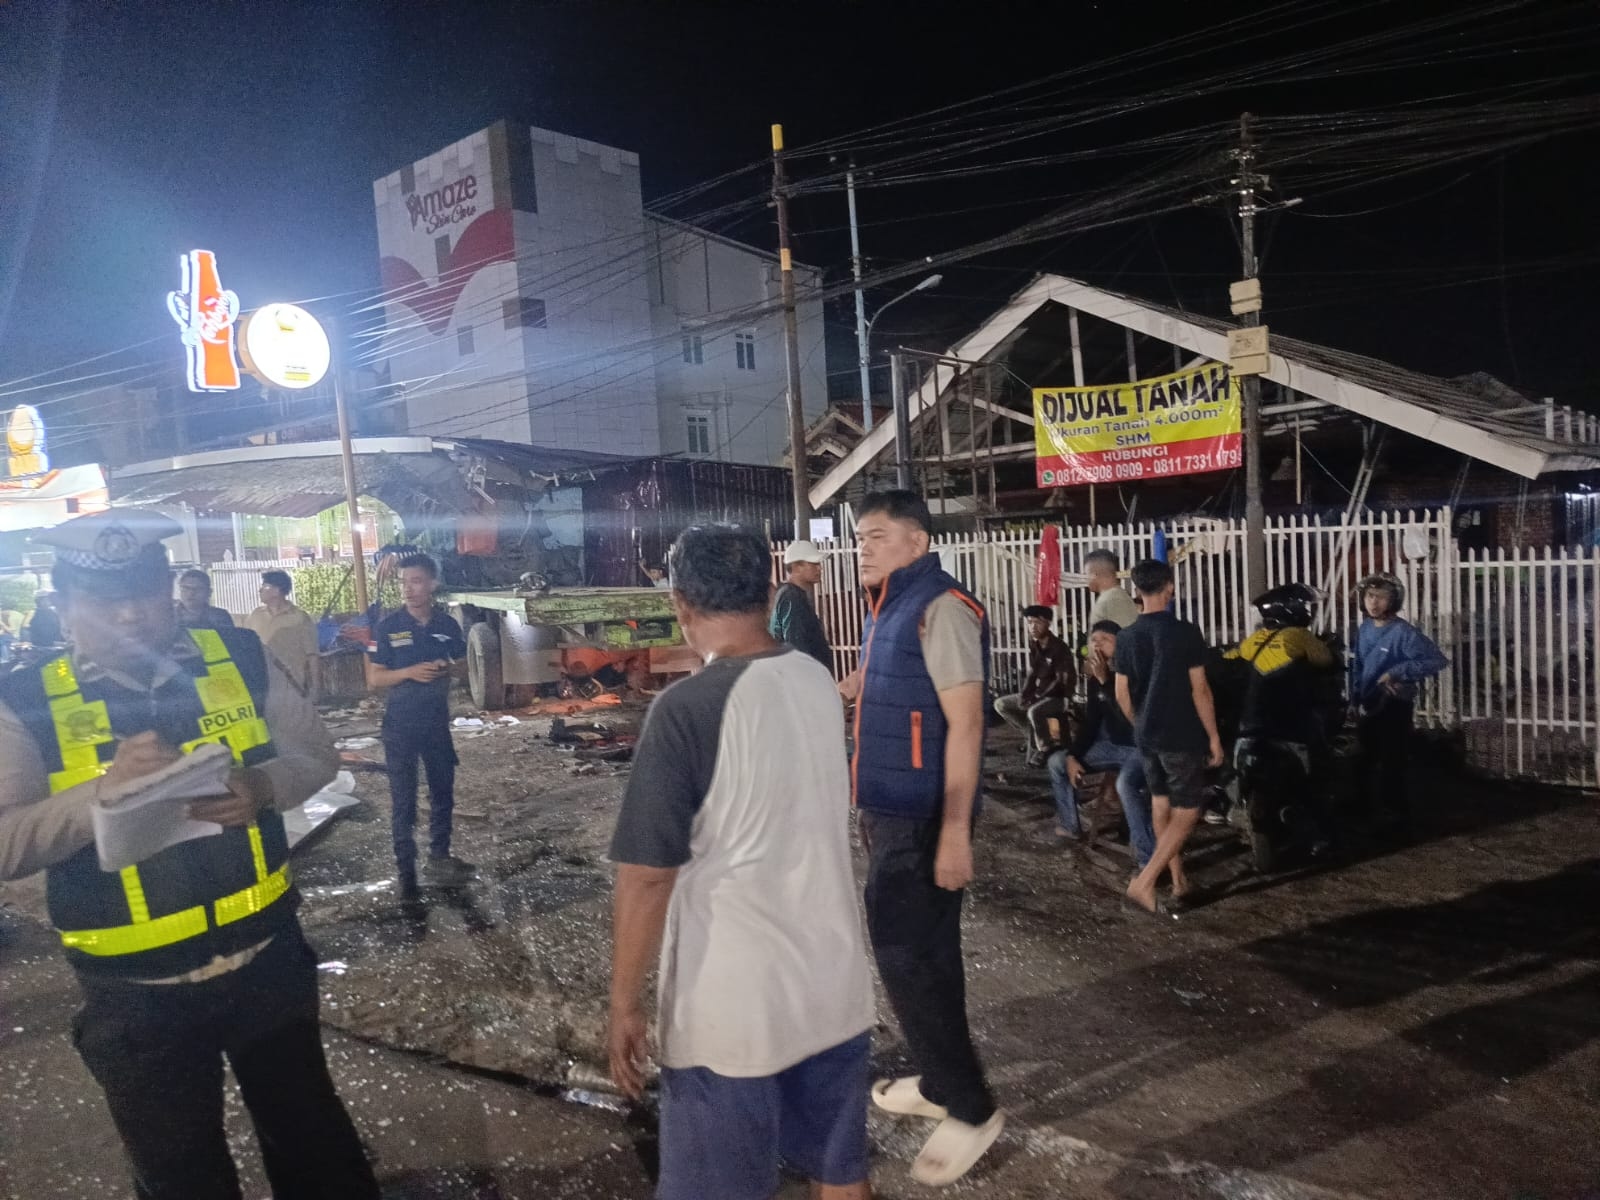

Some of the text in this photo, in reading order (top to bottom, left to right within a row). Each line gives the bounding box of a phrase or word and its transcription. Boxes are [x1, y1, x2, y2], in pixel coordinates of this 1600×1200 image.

[406, 175, 477, 231] Amaze
[1042, 365, 1231, 424] DIJUAL TANAH
[1104, 417, 1150, 432] Tanah
[1116, 432, 1151, 446] SHM
[1103, 446, 1168, 462] HUBUNGI
[1116, 463, 1143, 478] 0909
[1153, 457, 1181, 474] 0811
[1184, 452, 1212, 470] 7331
[202, 705, 254, 731] POLRI
